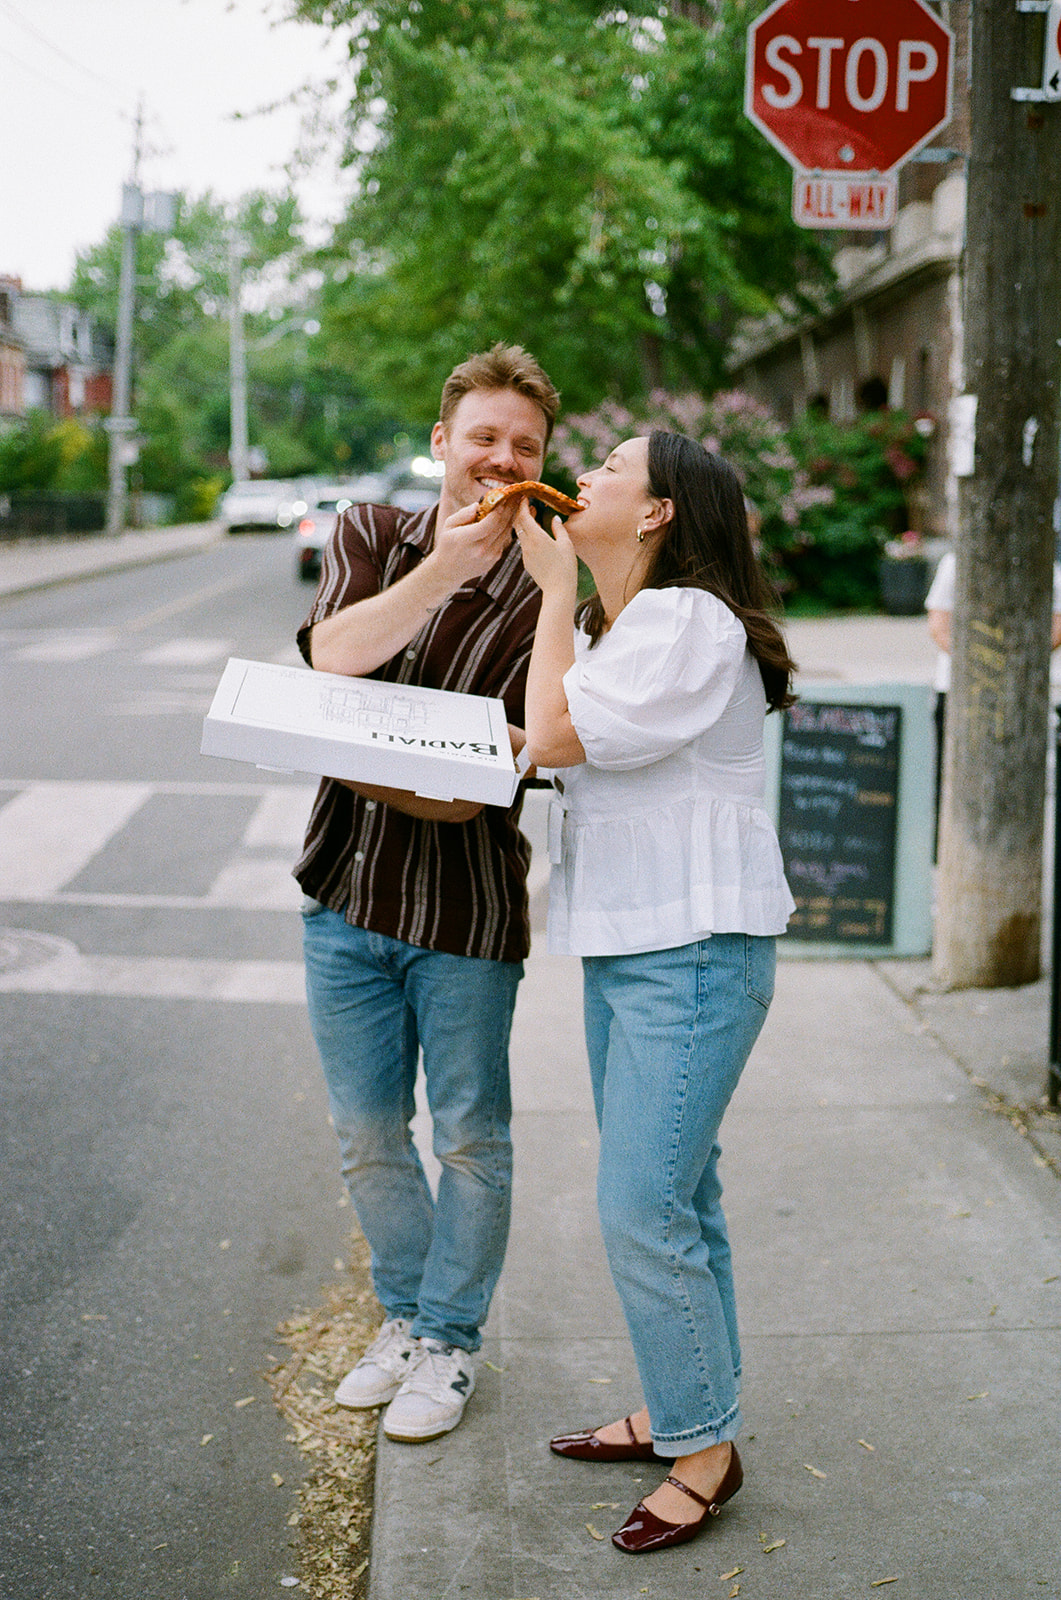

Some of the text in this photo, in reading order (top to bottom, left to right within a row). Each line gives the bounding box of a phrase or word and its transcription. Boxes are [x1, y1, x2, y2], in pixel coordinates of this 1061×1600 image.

[761, 34, 938, 112] STOP
[802, 184, 888, 218] ALL-WAY
[372, 732, 498, 757] BADIALI
[450, 1369, 469, 1396] N
